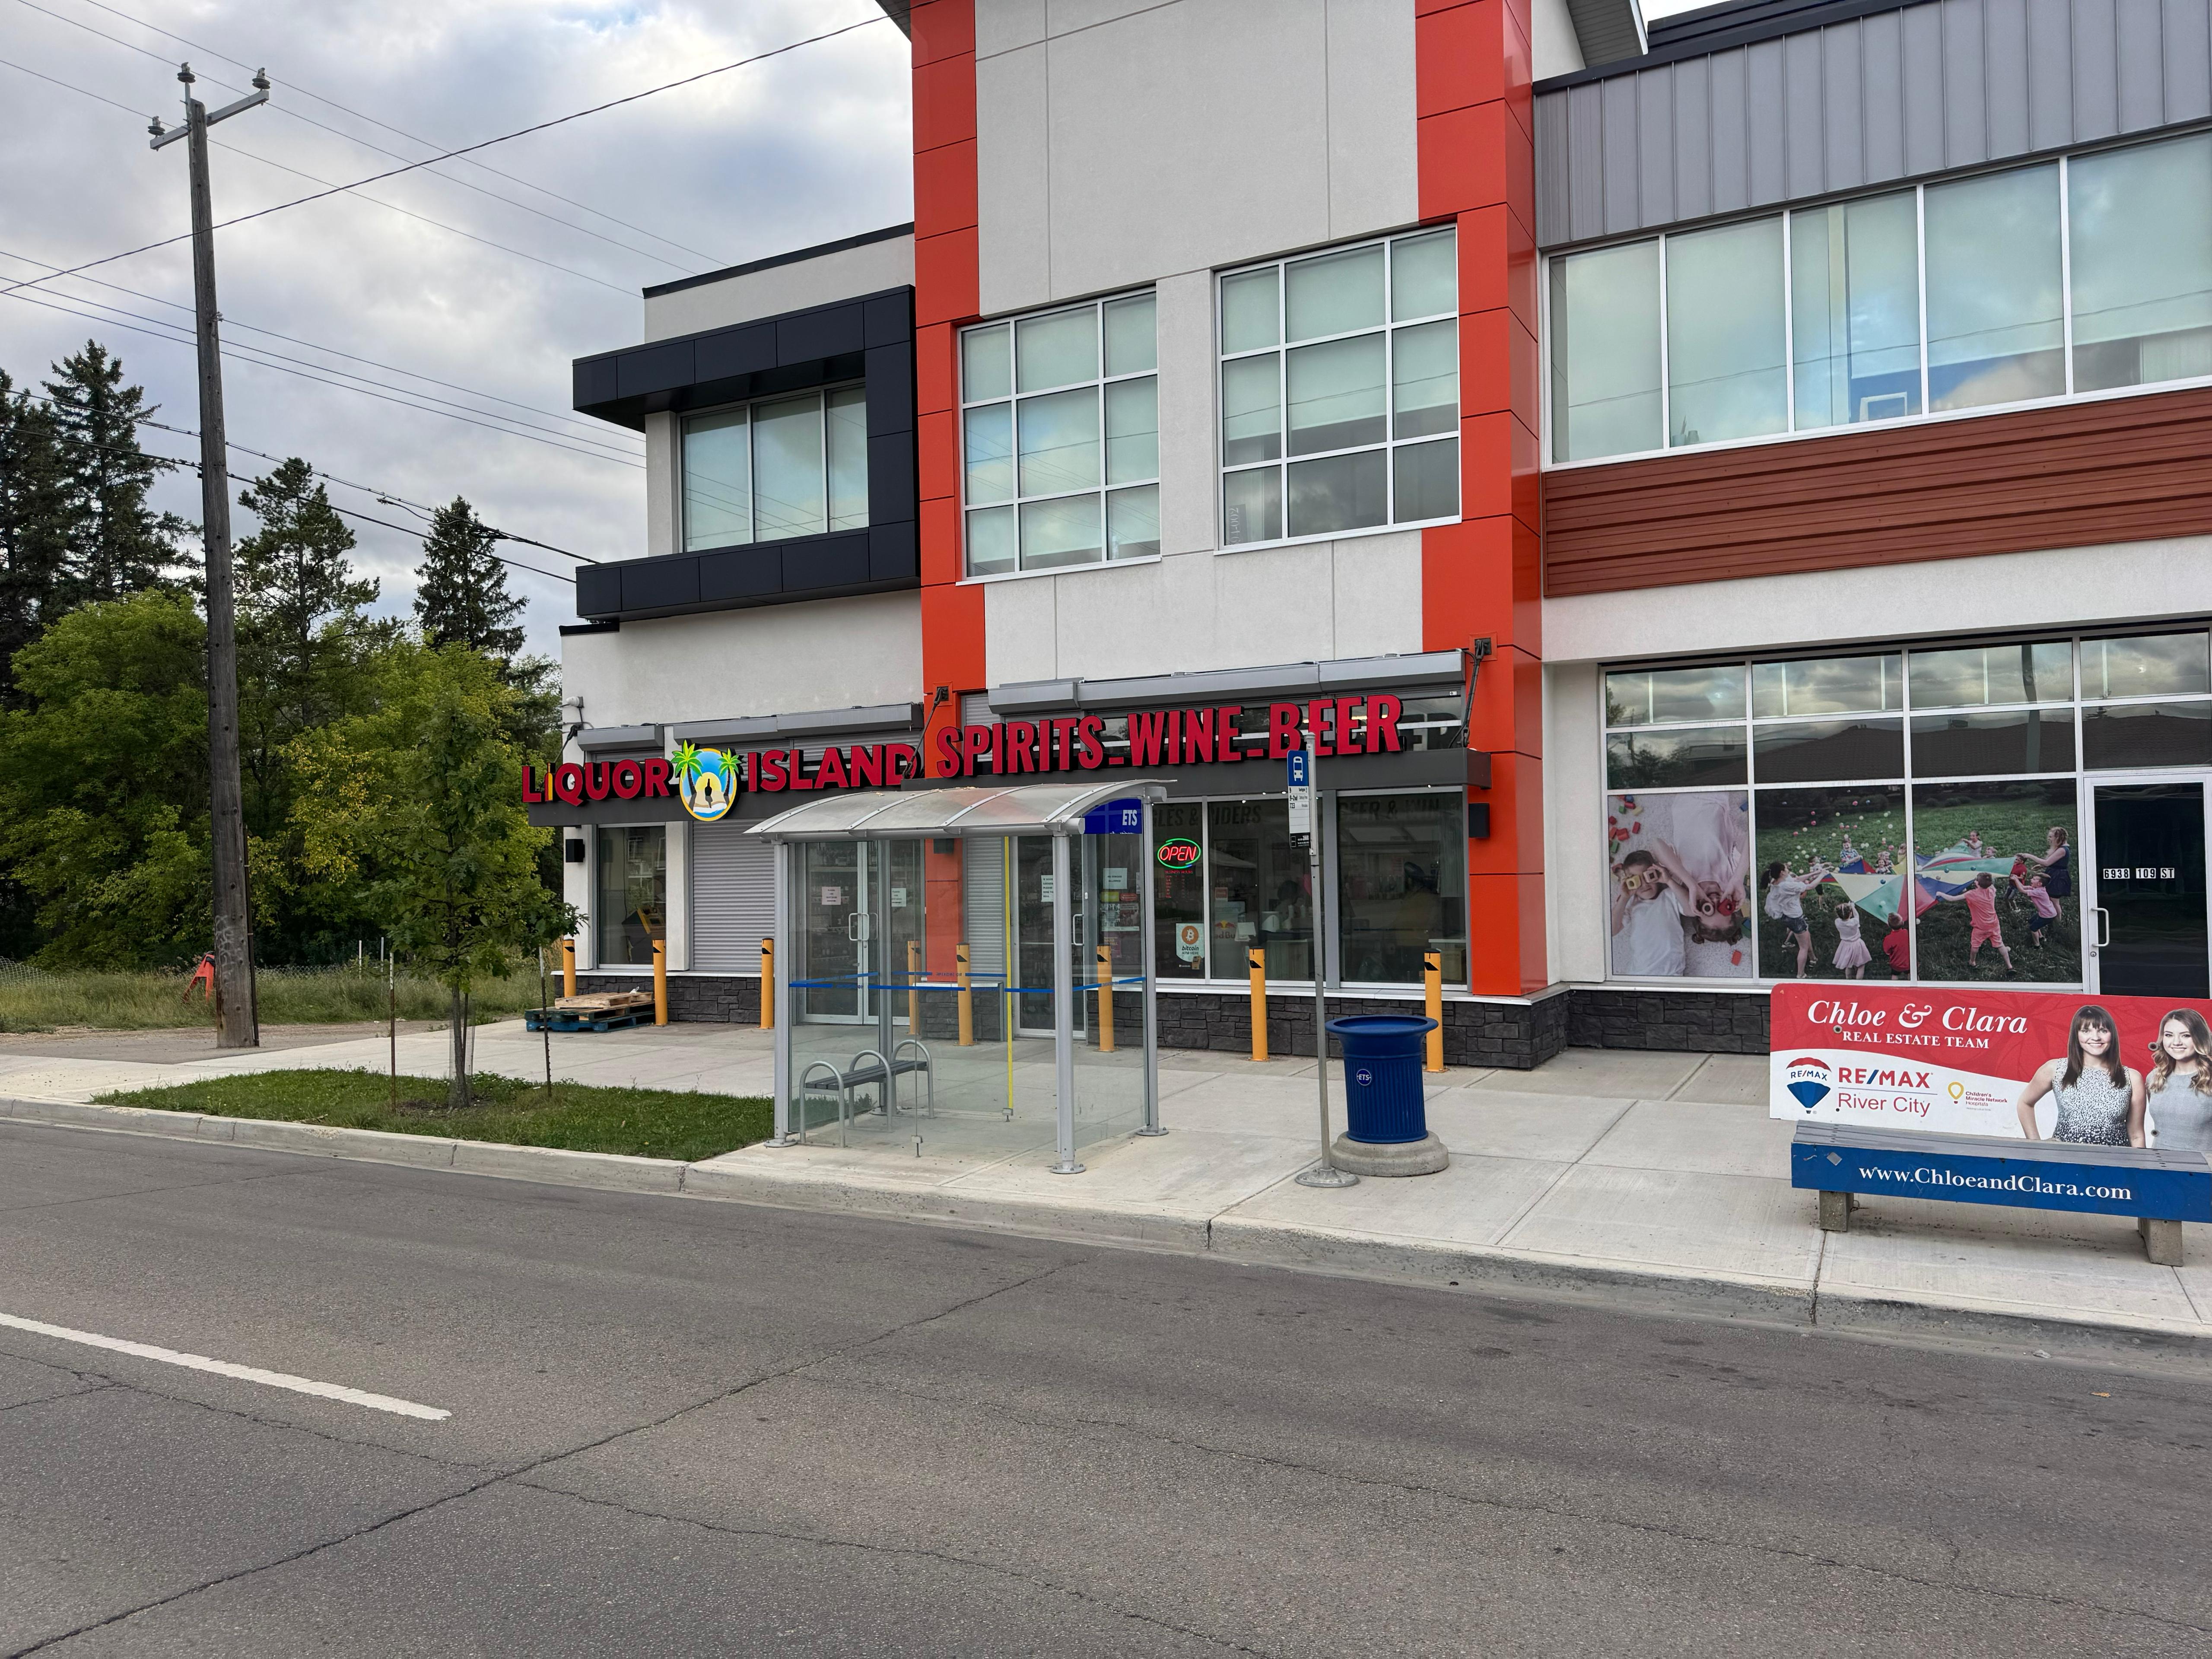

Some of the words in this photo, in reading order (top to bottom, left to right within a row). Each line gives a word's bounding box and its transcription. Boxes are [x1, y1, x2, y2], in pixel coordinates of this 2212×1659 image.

[522, 758, 671, 806] LIQUOR
[748, 744, 918, 791] ISLAND
[1122, 810, 1137, 826] ETS
[1211, 805, 1262, 825] IDERS
[1160, 846, 1197, 861] OPEN
[2104, 869, 2129, 878] 6938
[2137, 868, 2155, 878] 109
[2161, 868, 2174, 877] ST
[1808, 1000, 1885, 1027] Chloe
[1898, 1003, 1932, 1028] &
[1942, 1006, 2028, 1034] Clara
[1842, 1031, 1881, 1043] REAL
[1886, 1033, 1941, 1046] ESTATE
[1945, 1036, 1989, 1049] TEAM
[1791, 1070, 1827, 1081] RE/MAX
[1838, 1067, 1930, 1089] RE/MAX
[1838, 1092, 1887, 1110] River
[1893, 1096, 1931, 1118] City
[1859, 1167, 2132, 1201] www.ChloeandClara.com
